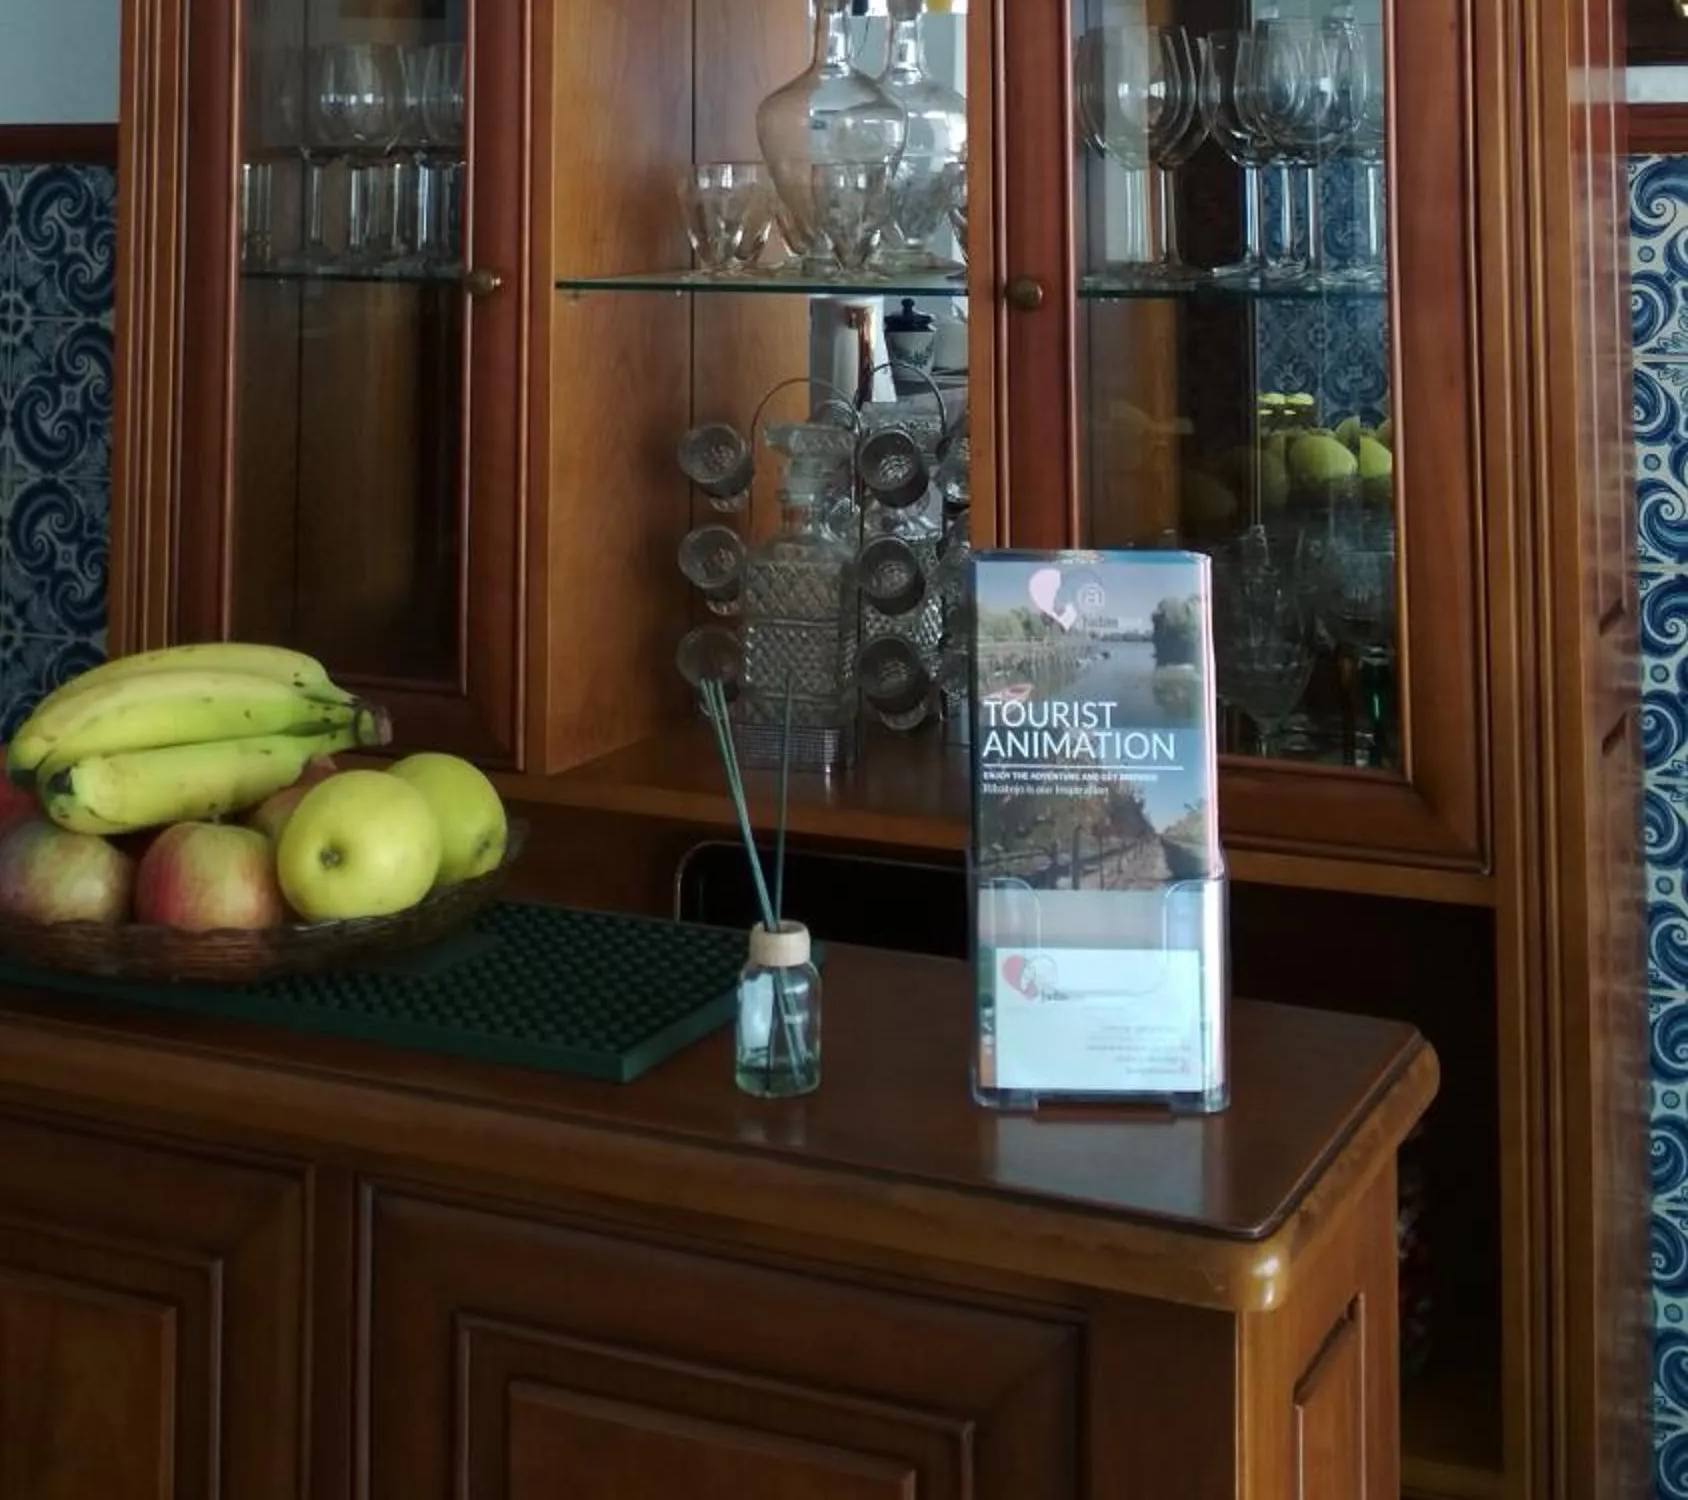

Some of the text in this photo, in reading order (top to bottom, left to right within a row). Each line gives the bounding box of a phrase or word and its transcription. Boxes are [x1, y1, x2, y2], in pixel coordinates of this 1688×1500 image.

[983, 701, 1118, 729] TOURIST
[982, 731, 1175, 760] ANIMATION
[983, 771, 1010, 780] ENJOY
[1013, 771, 1029, 780] THE
